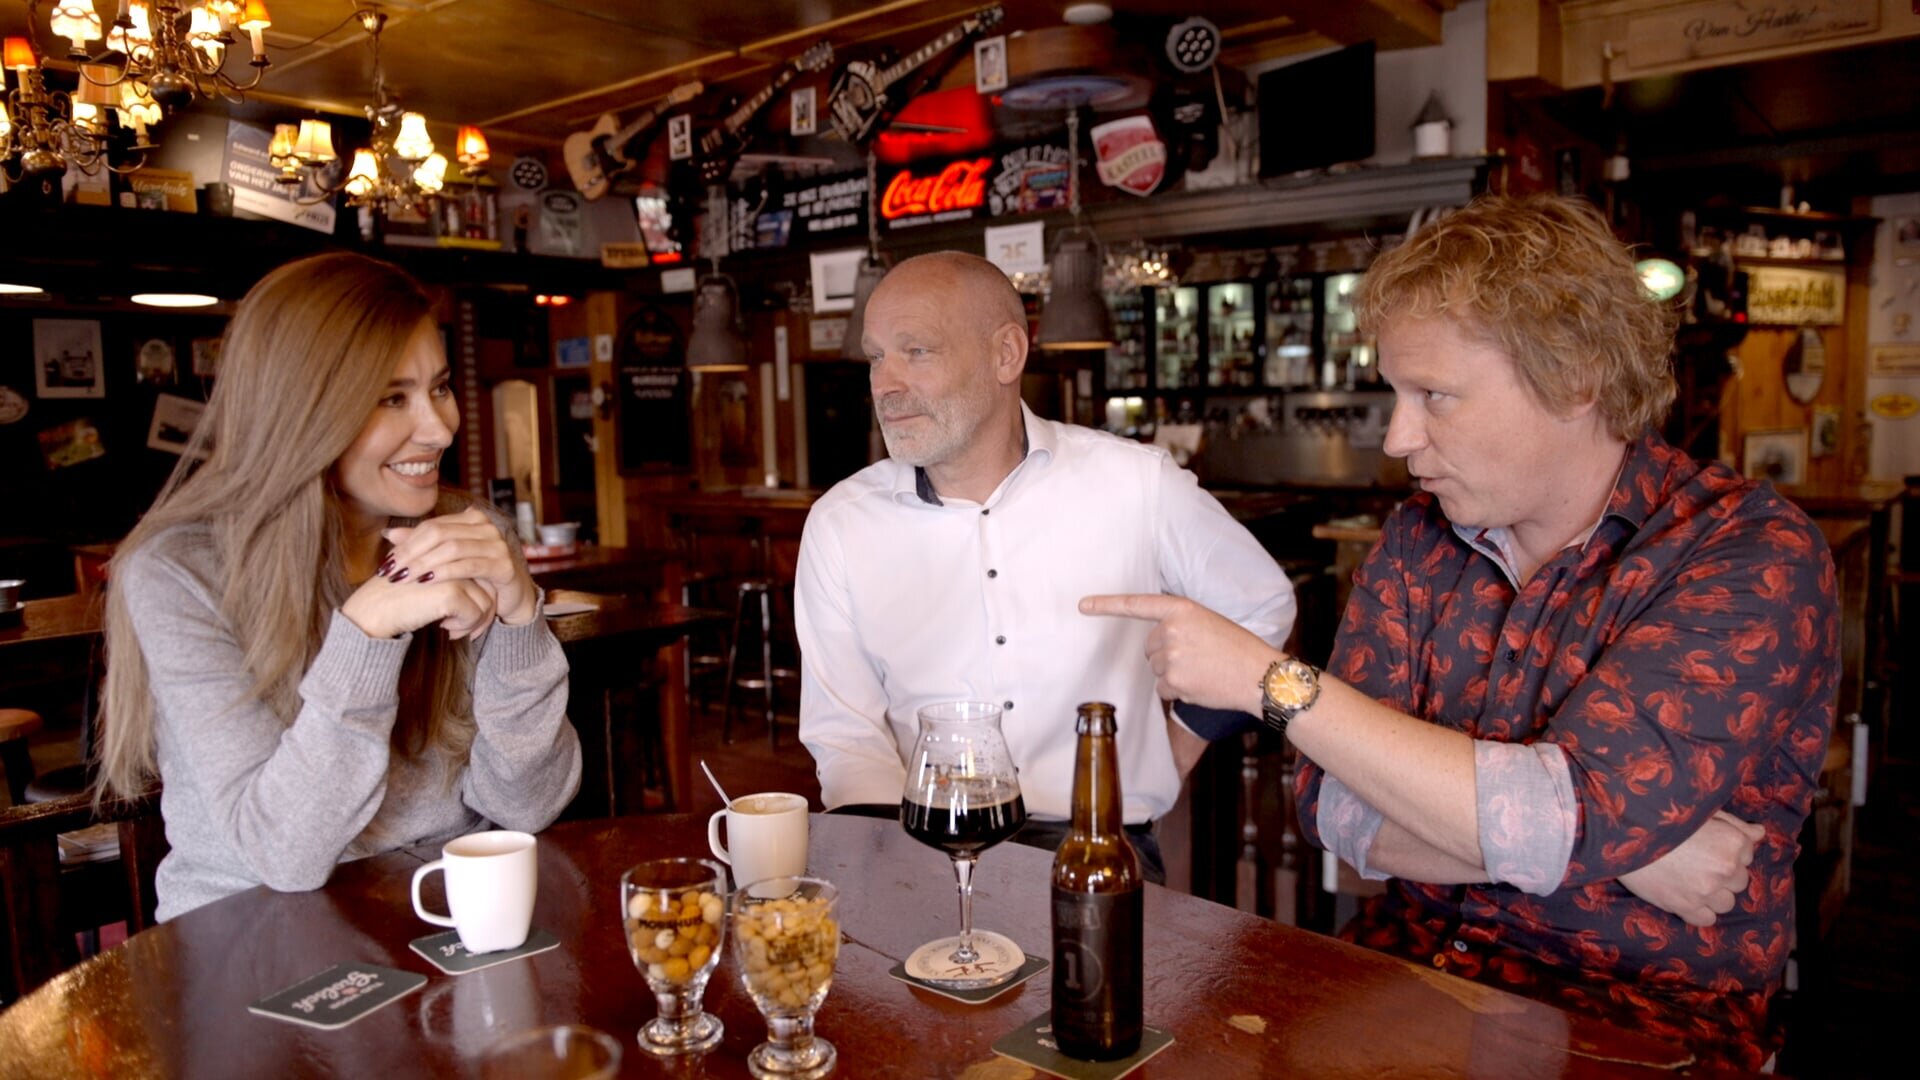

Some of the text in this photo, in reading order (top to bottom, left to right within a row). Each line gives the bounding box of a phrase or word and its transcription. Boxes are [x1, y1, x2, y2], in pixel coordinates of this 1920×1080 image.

[228, 169, 250, 185] VAN
[251, 176, 272, 192] HET
[229, 160, 277, 182] ONDERNE
[1064, 951, 1081, 989] 1
[291, 970, 379, 1014] Grolsch
